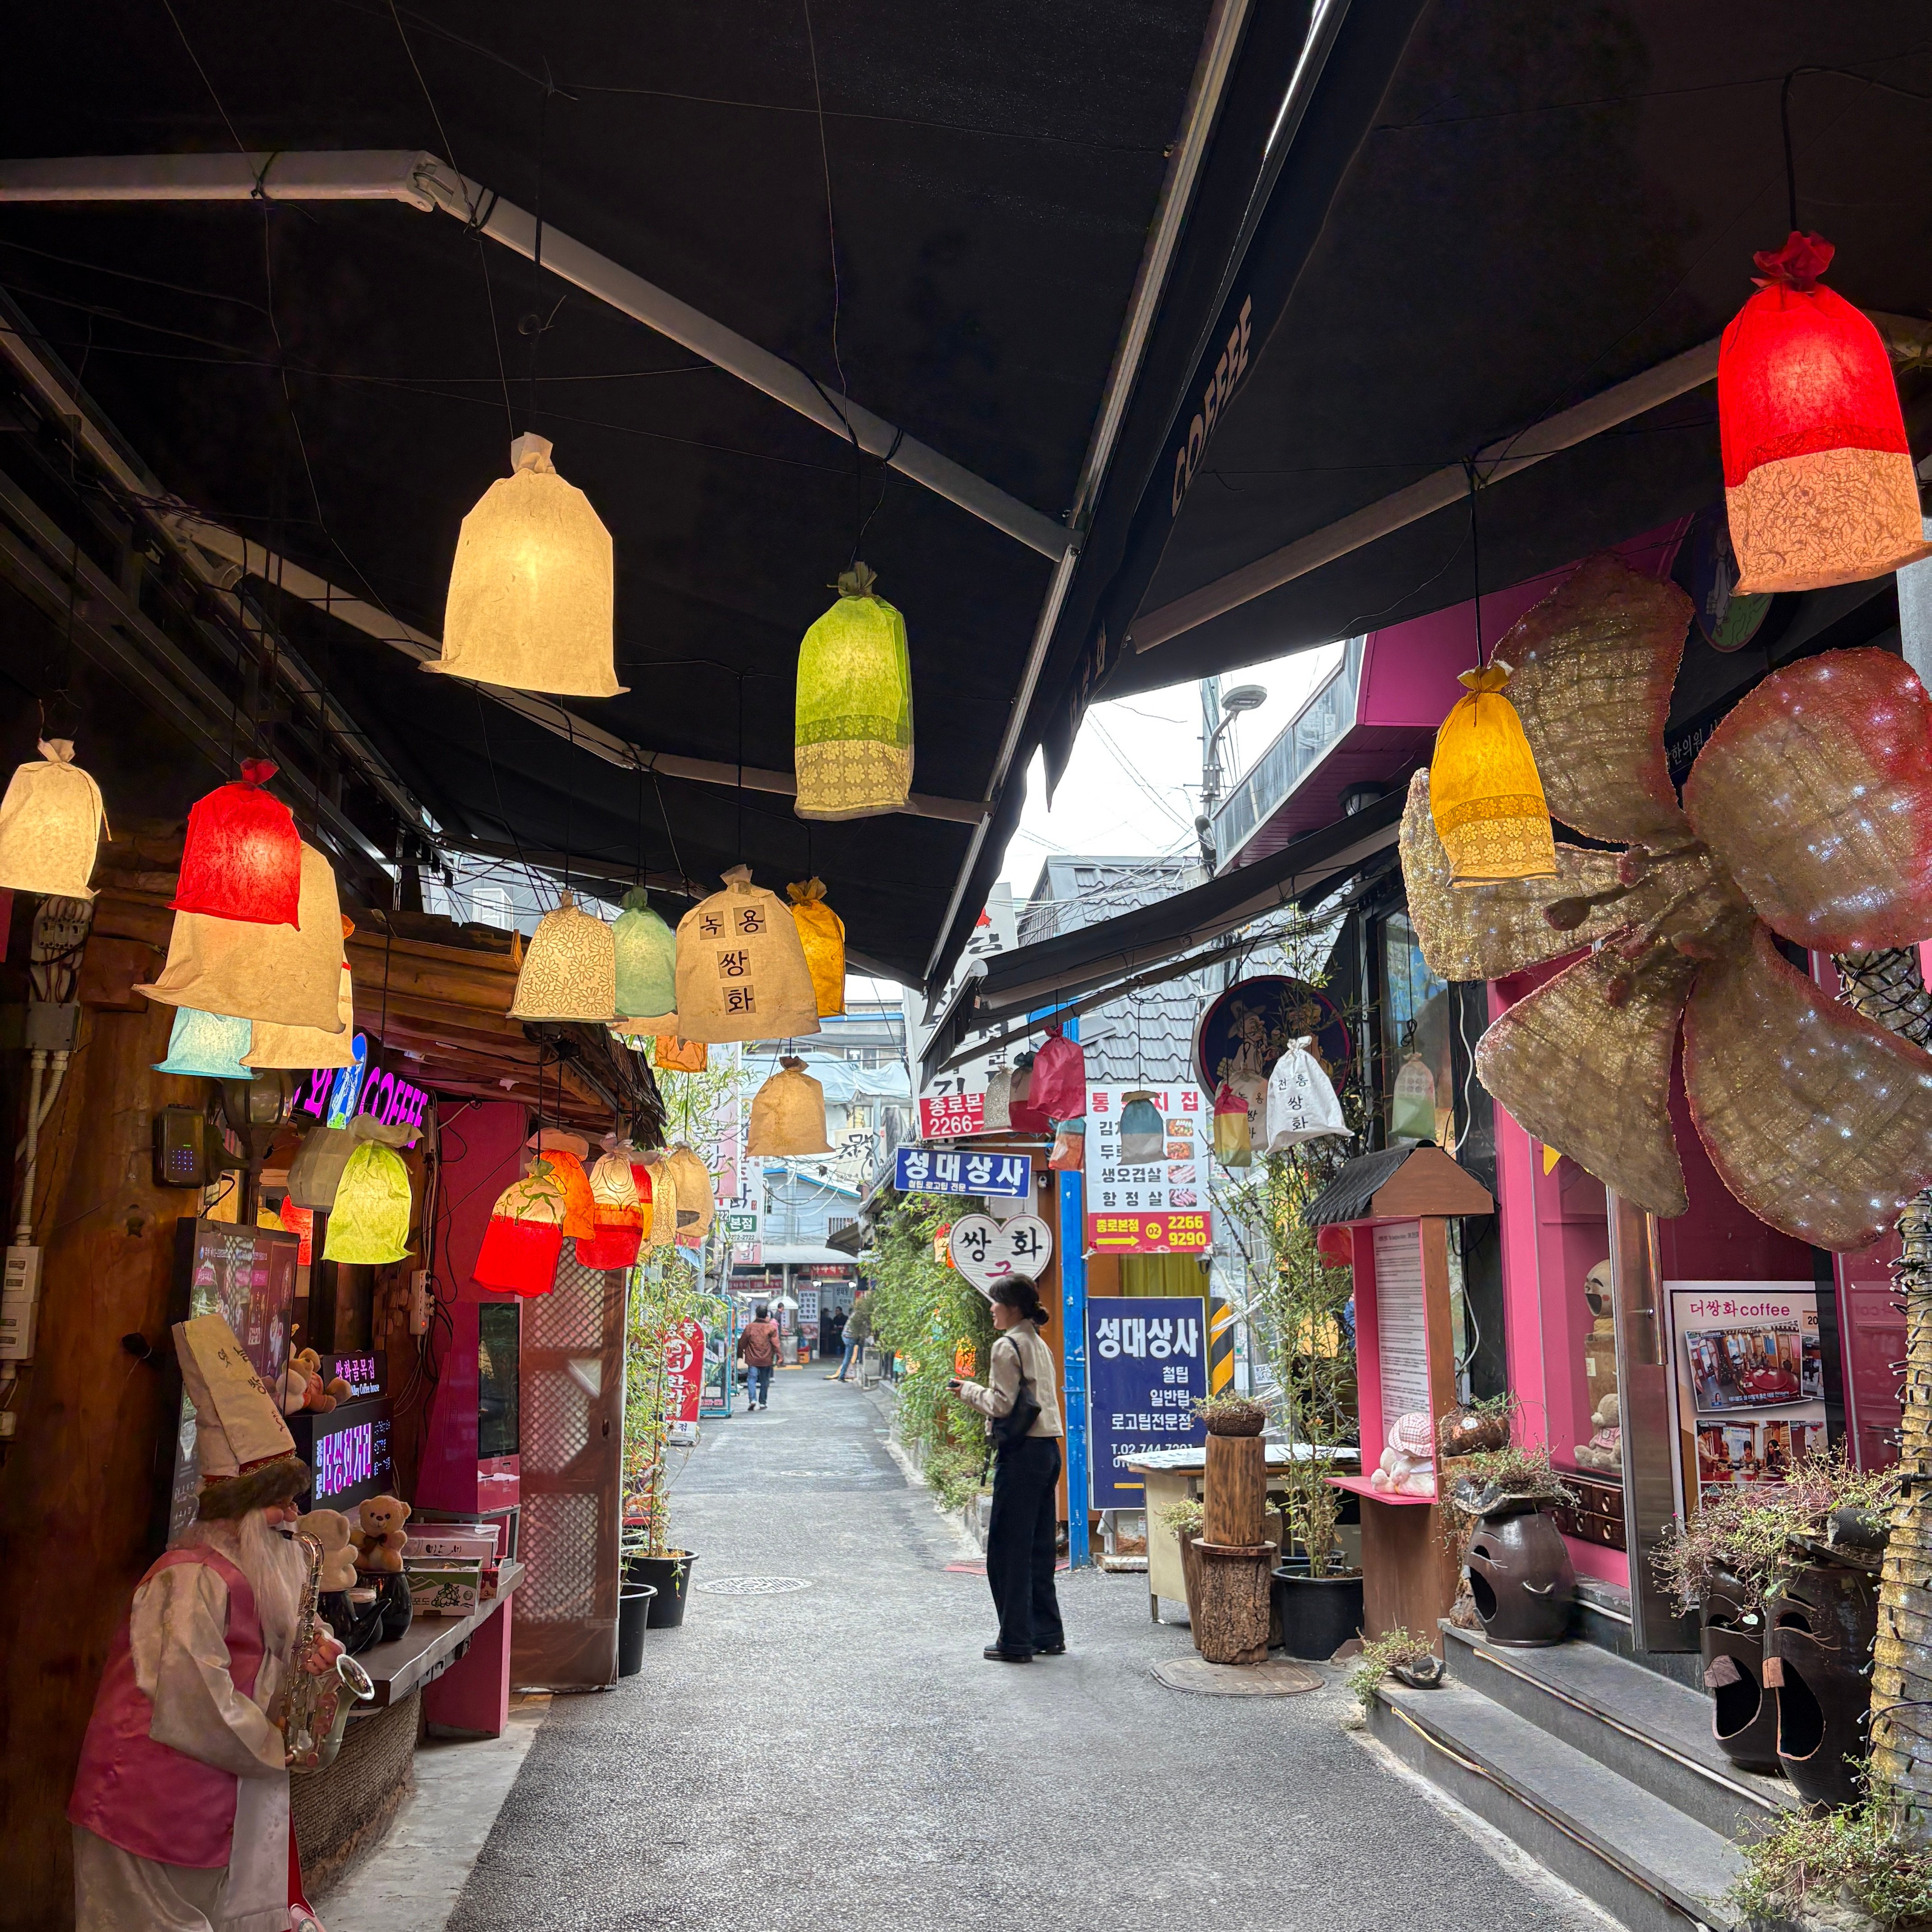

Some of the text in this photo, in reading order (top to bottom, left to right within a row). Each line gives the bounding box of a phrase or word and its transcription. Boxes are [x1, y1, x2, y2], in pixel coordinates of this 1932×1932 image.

[1173, 294, 1252, 517] COFFEE
[700, 909, 764, 934] 녹용
[1278, 1074, 1309, 1091] 전통
[929, 1094, 984, 1117] 종로본
[1092, 1091, 1199, 1113] 통지집
[904, 1152, 1024, 1186] 성대상사
[1101, 1168, 1161, 1183] 생오겹살
[1102, 1191, 1163, 1207] 항정살
[730, 1217, 753, 1230] 본점
[1096, 1216, 1204, 1235] 종로본점 02 2266
[959, 1227, 1043, 1262] 쌍화
[1168, 1232, 1207, 1246] 9290
[1096, 1318, 1198, 1358] 성대상사
[336, 1357, 375, 1383] 쌍화골목집
[1163, 1366, 1189, 1384] 철팁
[1150, 1389, 1190, 1407] 일반팁
[1111, 1413, 1191, 1431] 로고팁전문점
